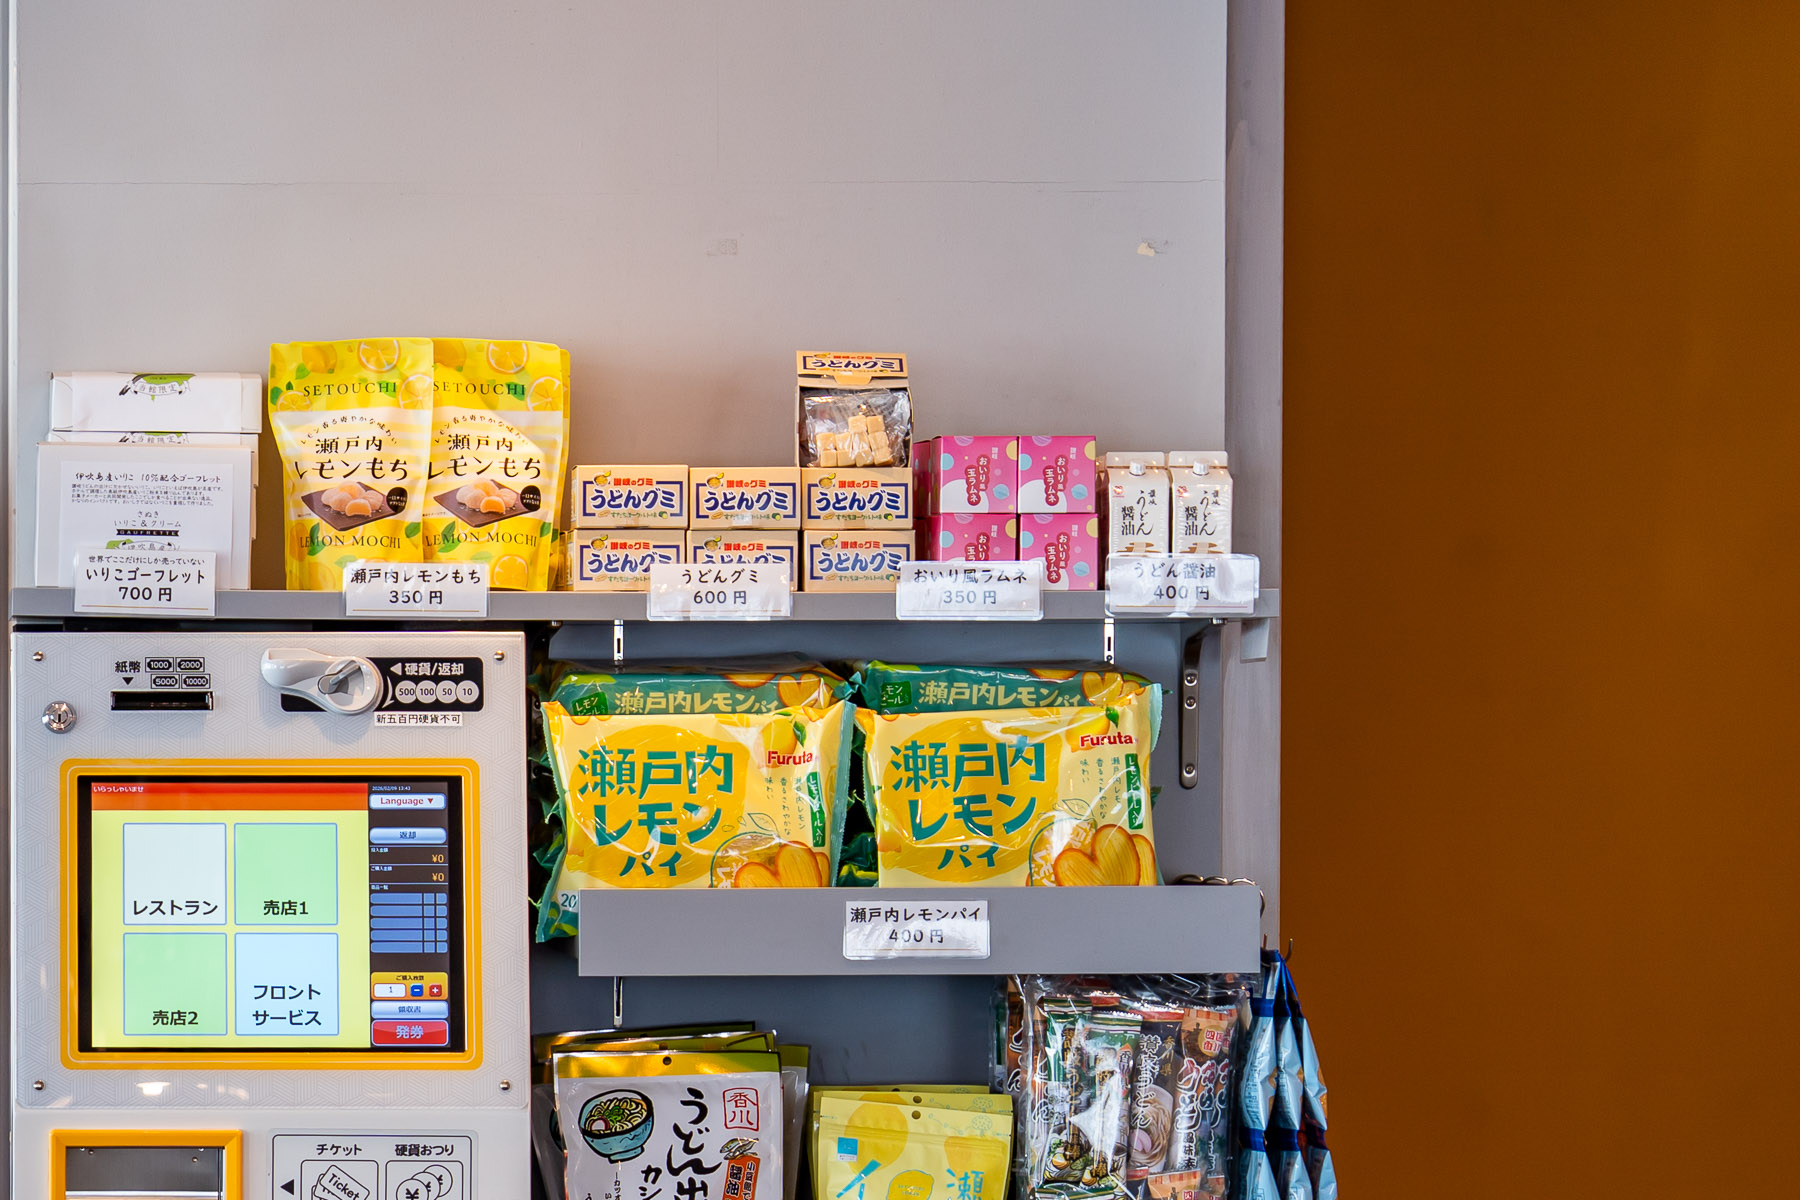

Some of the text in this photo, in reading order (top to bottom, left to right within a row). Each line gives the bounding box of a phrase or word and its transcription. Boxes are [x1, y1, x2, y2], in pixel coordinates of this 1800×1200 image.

[303, 382, 397, 397] SETOUCHI
[315, 436, 383, 454] 瀬戸内
[294, 457, 409, 481] レモンもち
[590, 489, 676, 509] うどんグミ
[300, 535, 401, 549] LEMON MOCHI
[89, 556, 205, 565] 世界でここだけにしか売っていない
[86, 567, 205, 584] いりこゴーフレット
[350, 569, 482, 584] 瀬戸内レモンもち
[681, 569, 759, 584] うどんグミ
[119, 587, 172, 602] 700 円
[389, 590, 443, 605] 350 円
[693, 591, 747, 604] 600 円
[115, 661, 141, 673] 紙幣
[405, 662, 464, 675] 硬貨/返却
[399, 688, 472, 696] 500 100 50 10
[377, 714, 460, 724] 新五百円硬貨不可
[767, 750, 813, 766] Furuta
[578, 745, 734, 799] 瀬戸内
[381, 797, 423, 805] Language
[594, 802, 722, 847] レモン
[619, 851, 683, 877] パイ
[133, 900, 218, 917] レストラン
[263, 900, 309, 917] 売店1
[850, 907, 981, 923] 瀬戸内レモンパイ
[889, 929, 944, 944] 400 円
[252, 983, 321, 1001] フロント
[152, 1010, 199, 1027] 売店2
[252, 1010, 322, 1027] サービス
[395, 1024, 424, 1040] 発券
[316, 1144, 362, 1156] チケット
[395, 1144, 454, 1157] 硬貨おつり
